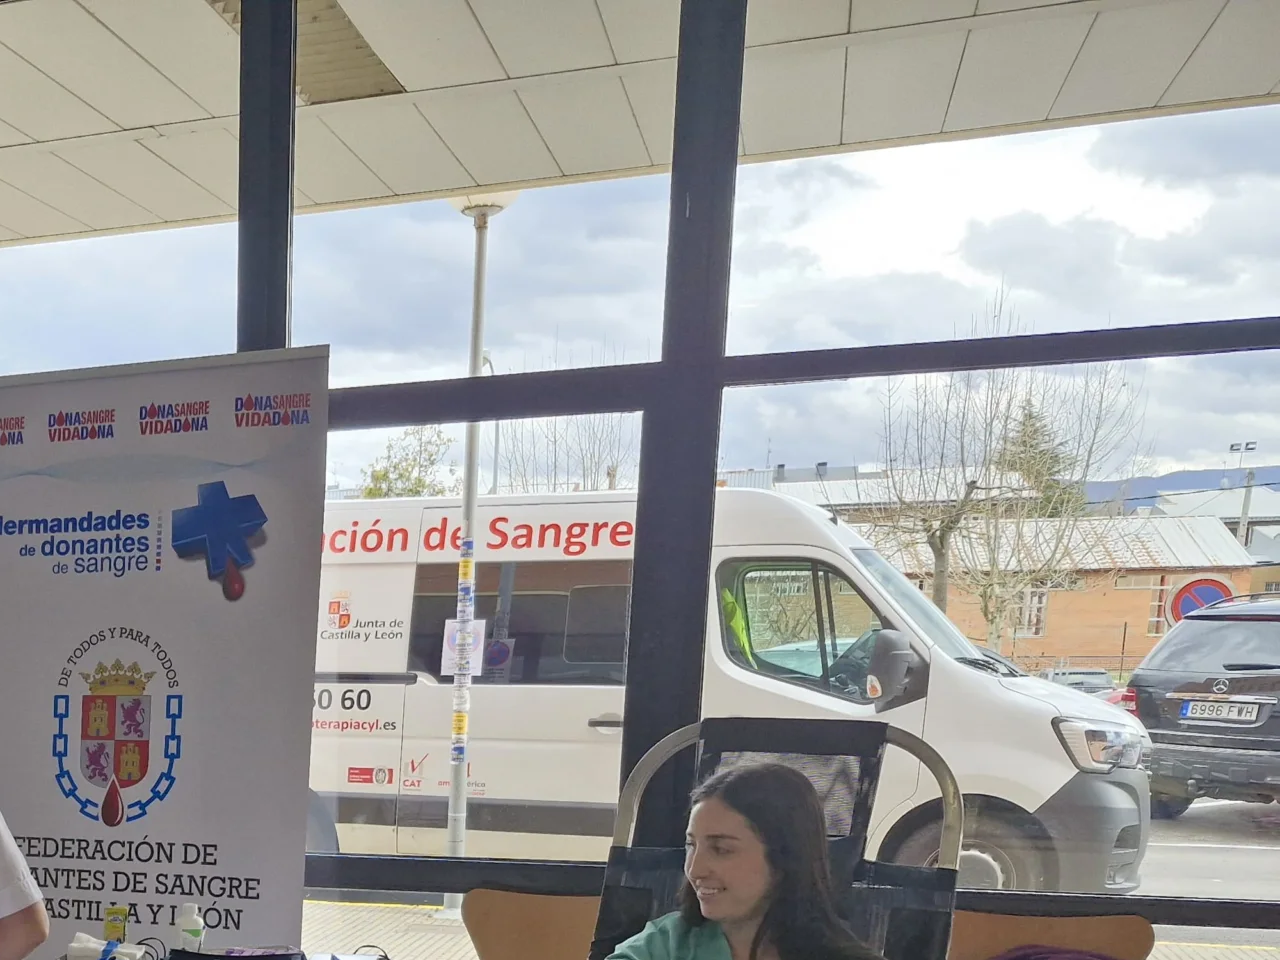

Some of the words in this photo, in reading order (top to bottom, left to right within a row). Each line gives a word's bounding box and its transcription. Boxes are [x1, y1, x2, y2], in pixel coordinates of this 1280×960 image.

[19, 545, 36, 557] de
[41, 534, 150, 556] donantes
[321, 519, 409, 553] ción
[423, 517, 462, 551] de
[486, 516, 634, 556] Sangre
[52, 561, 69, 574] de
[74, 554, 148, 578] sangre
[353, 619, 386, 628] Junta
[389, 619, 404, 628] de
[320, 630, 361, 640] Castilla
[364, 632, 371, 642] y
[375, 629, 403, 640] León
[58, 667, 72, 688] DE
[67, 630, 106, 666] TODOS
[108, 627, 117, 639] Y
[119, 627, 151, 648] PARA
[151, 642, 179, 688] TODOS
[313, 689, 332, 710] 0
[341, 689, 372, 711] 60
[1191, 704, 1224, 716] 6996
[1227, 705, 1254, 718] FWH
[403, 779, 422, 788] CAT
[15, 835, 175, 863] FEDERACIÓN
[182, 843, 218, 866] DE
[28, 867, 105, 891] ANTES
[113, 871, 147, 893] DE
[155, 873, 261, 900] SANGRE
[147, 904, 165, 926] Y
